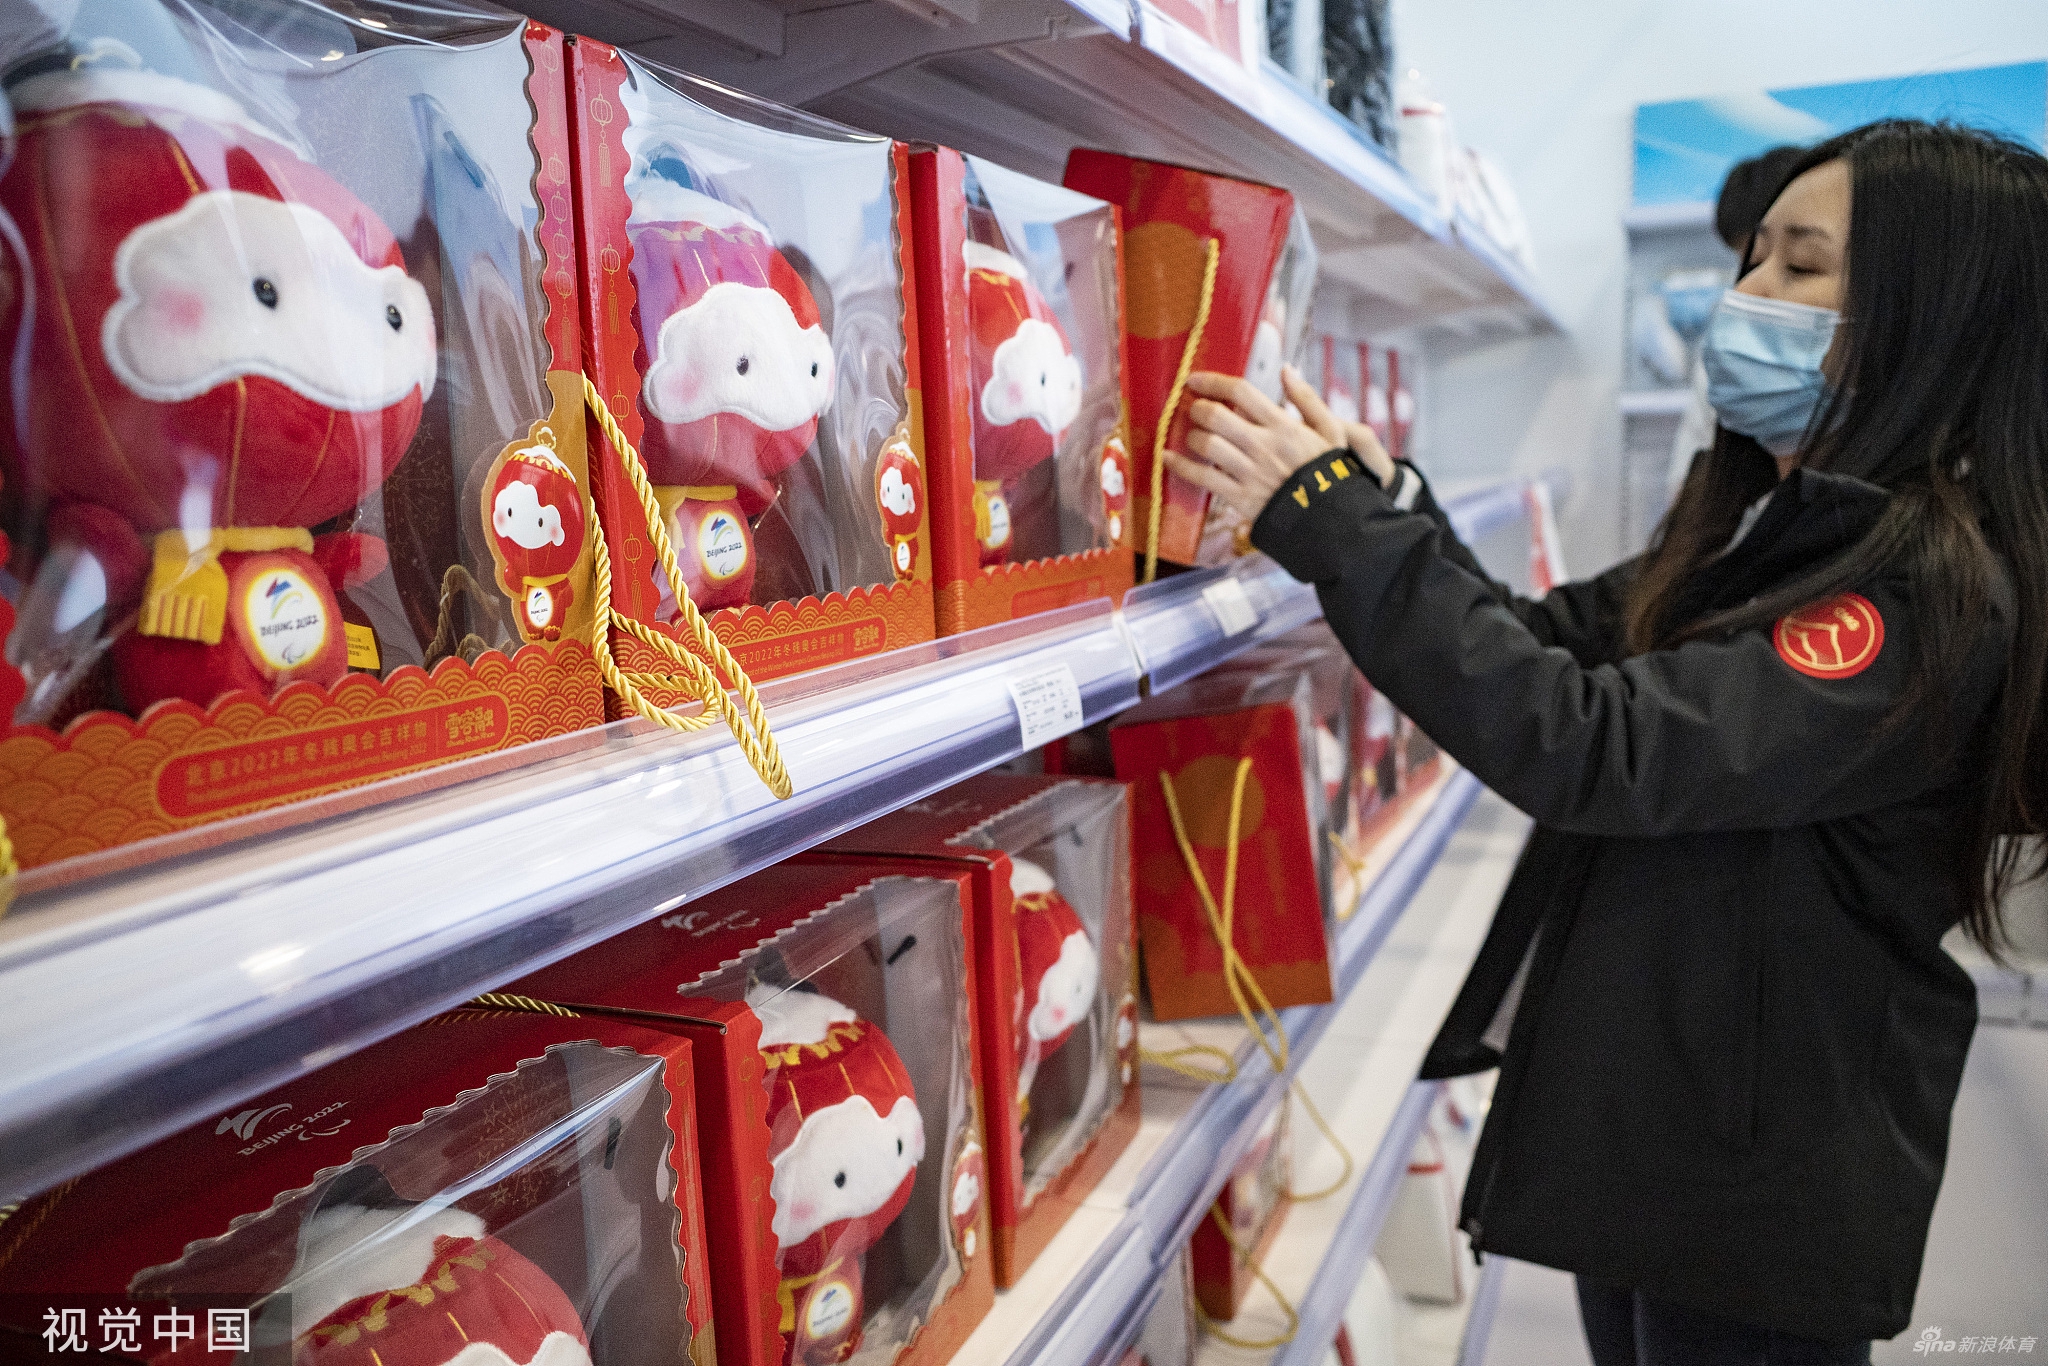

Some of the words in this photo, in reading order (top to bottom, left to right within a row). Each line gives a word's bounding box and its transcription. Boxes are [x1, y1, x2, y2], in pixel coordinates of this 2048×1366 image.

[706, 546, 728, 557] BEIJING
[728, 542, 742, 551] 2022
[260, 620, 293, 637] BEIJING
[296, 614, 318, 630] 2022
[237, 1123, 304, 1155] BEIJING
[302, 1100, 351, 1123] 2022
